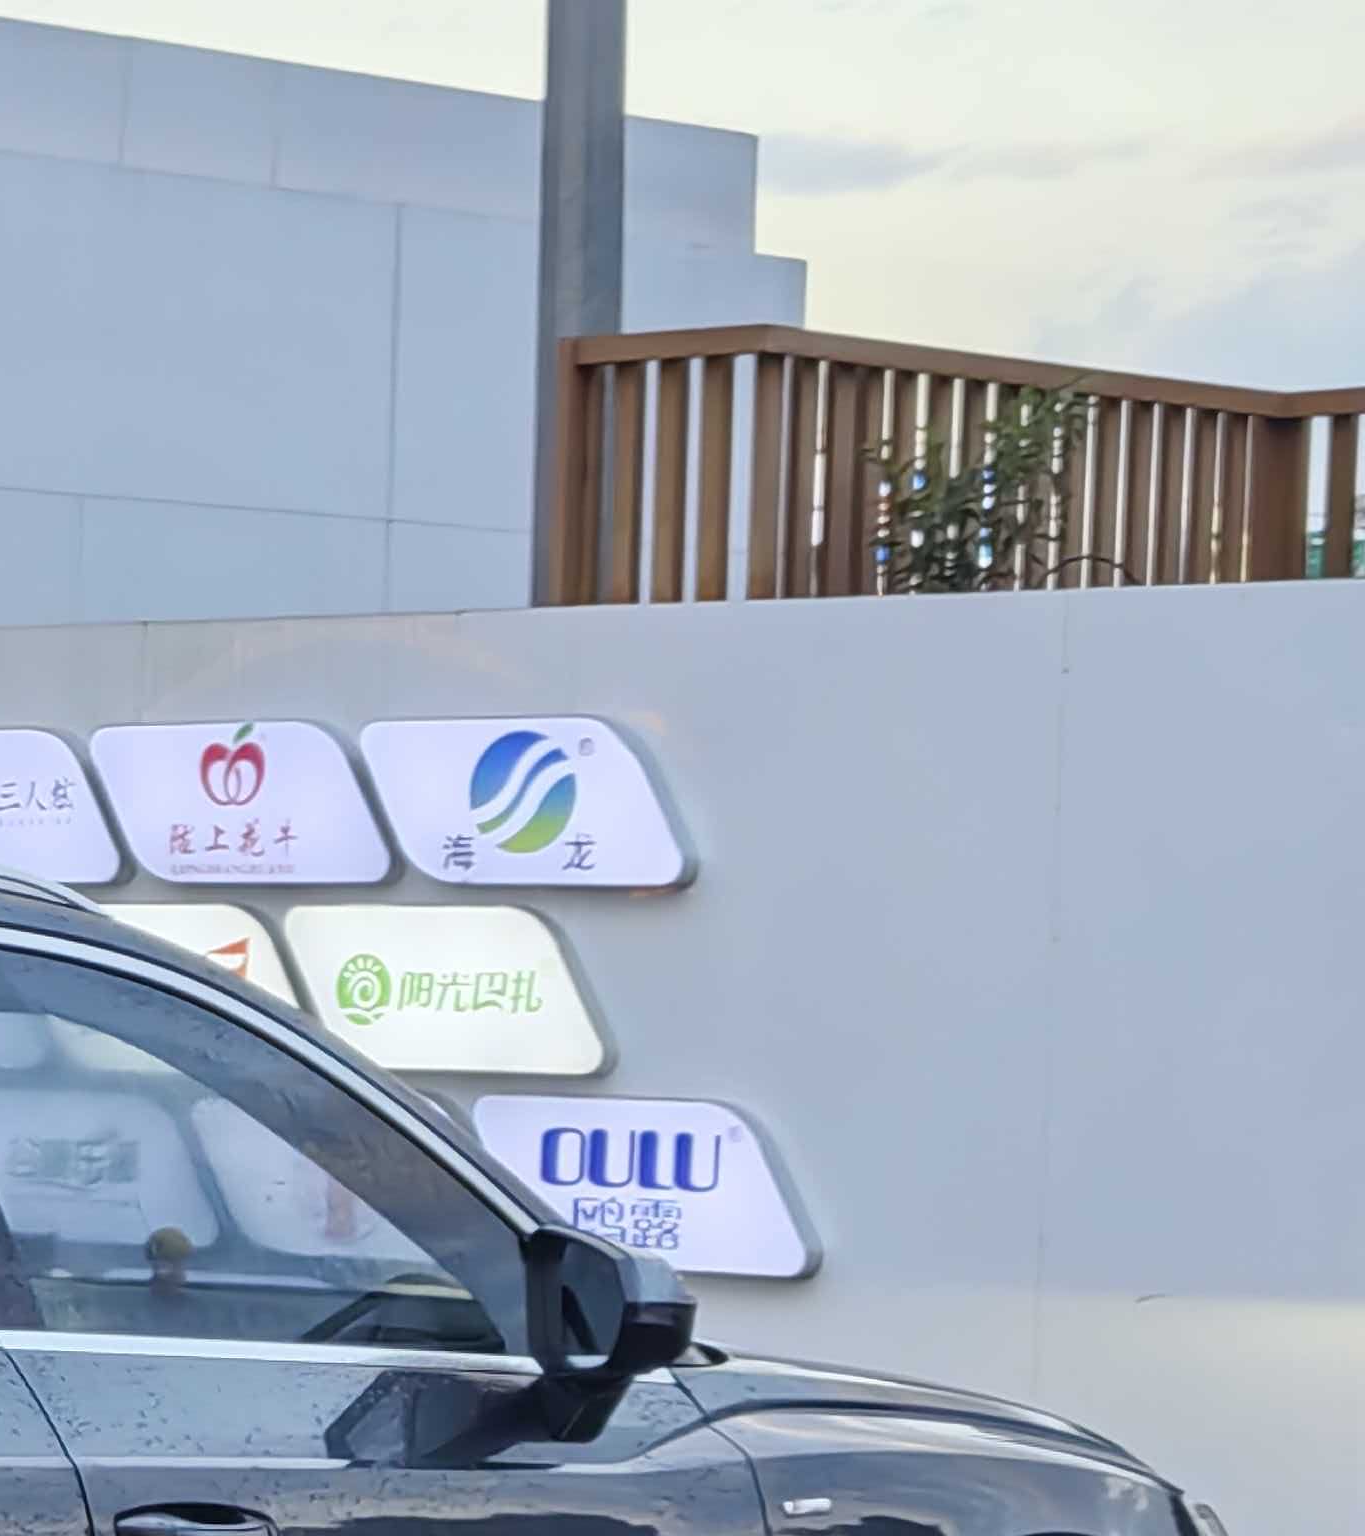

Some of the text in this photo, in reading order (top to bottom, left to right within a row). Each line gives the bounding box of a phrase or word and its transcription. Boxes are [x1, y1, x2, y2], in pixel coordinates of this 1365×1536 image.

[396, 969, 544, 1014] 阳光巴扎
[540, 1126, 722, 1193] OULU
